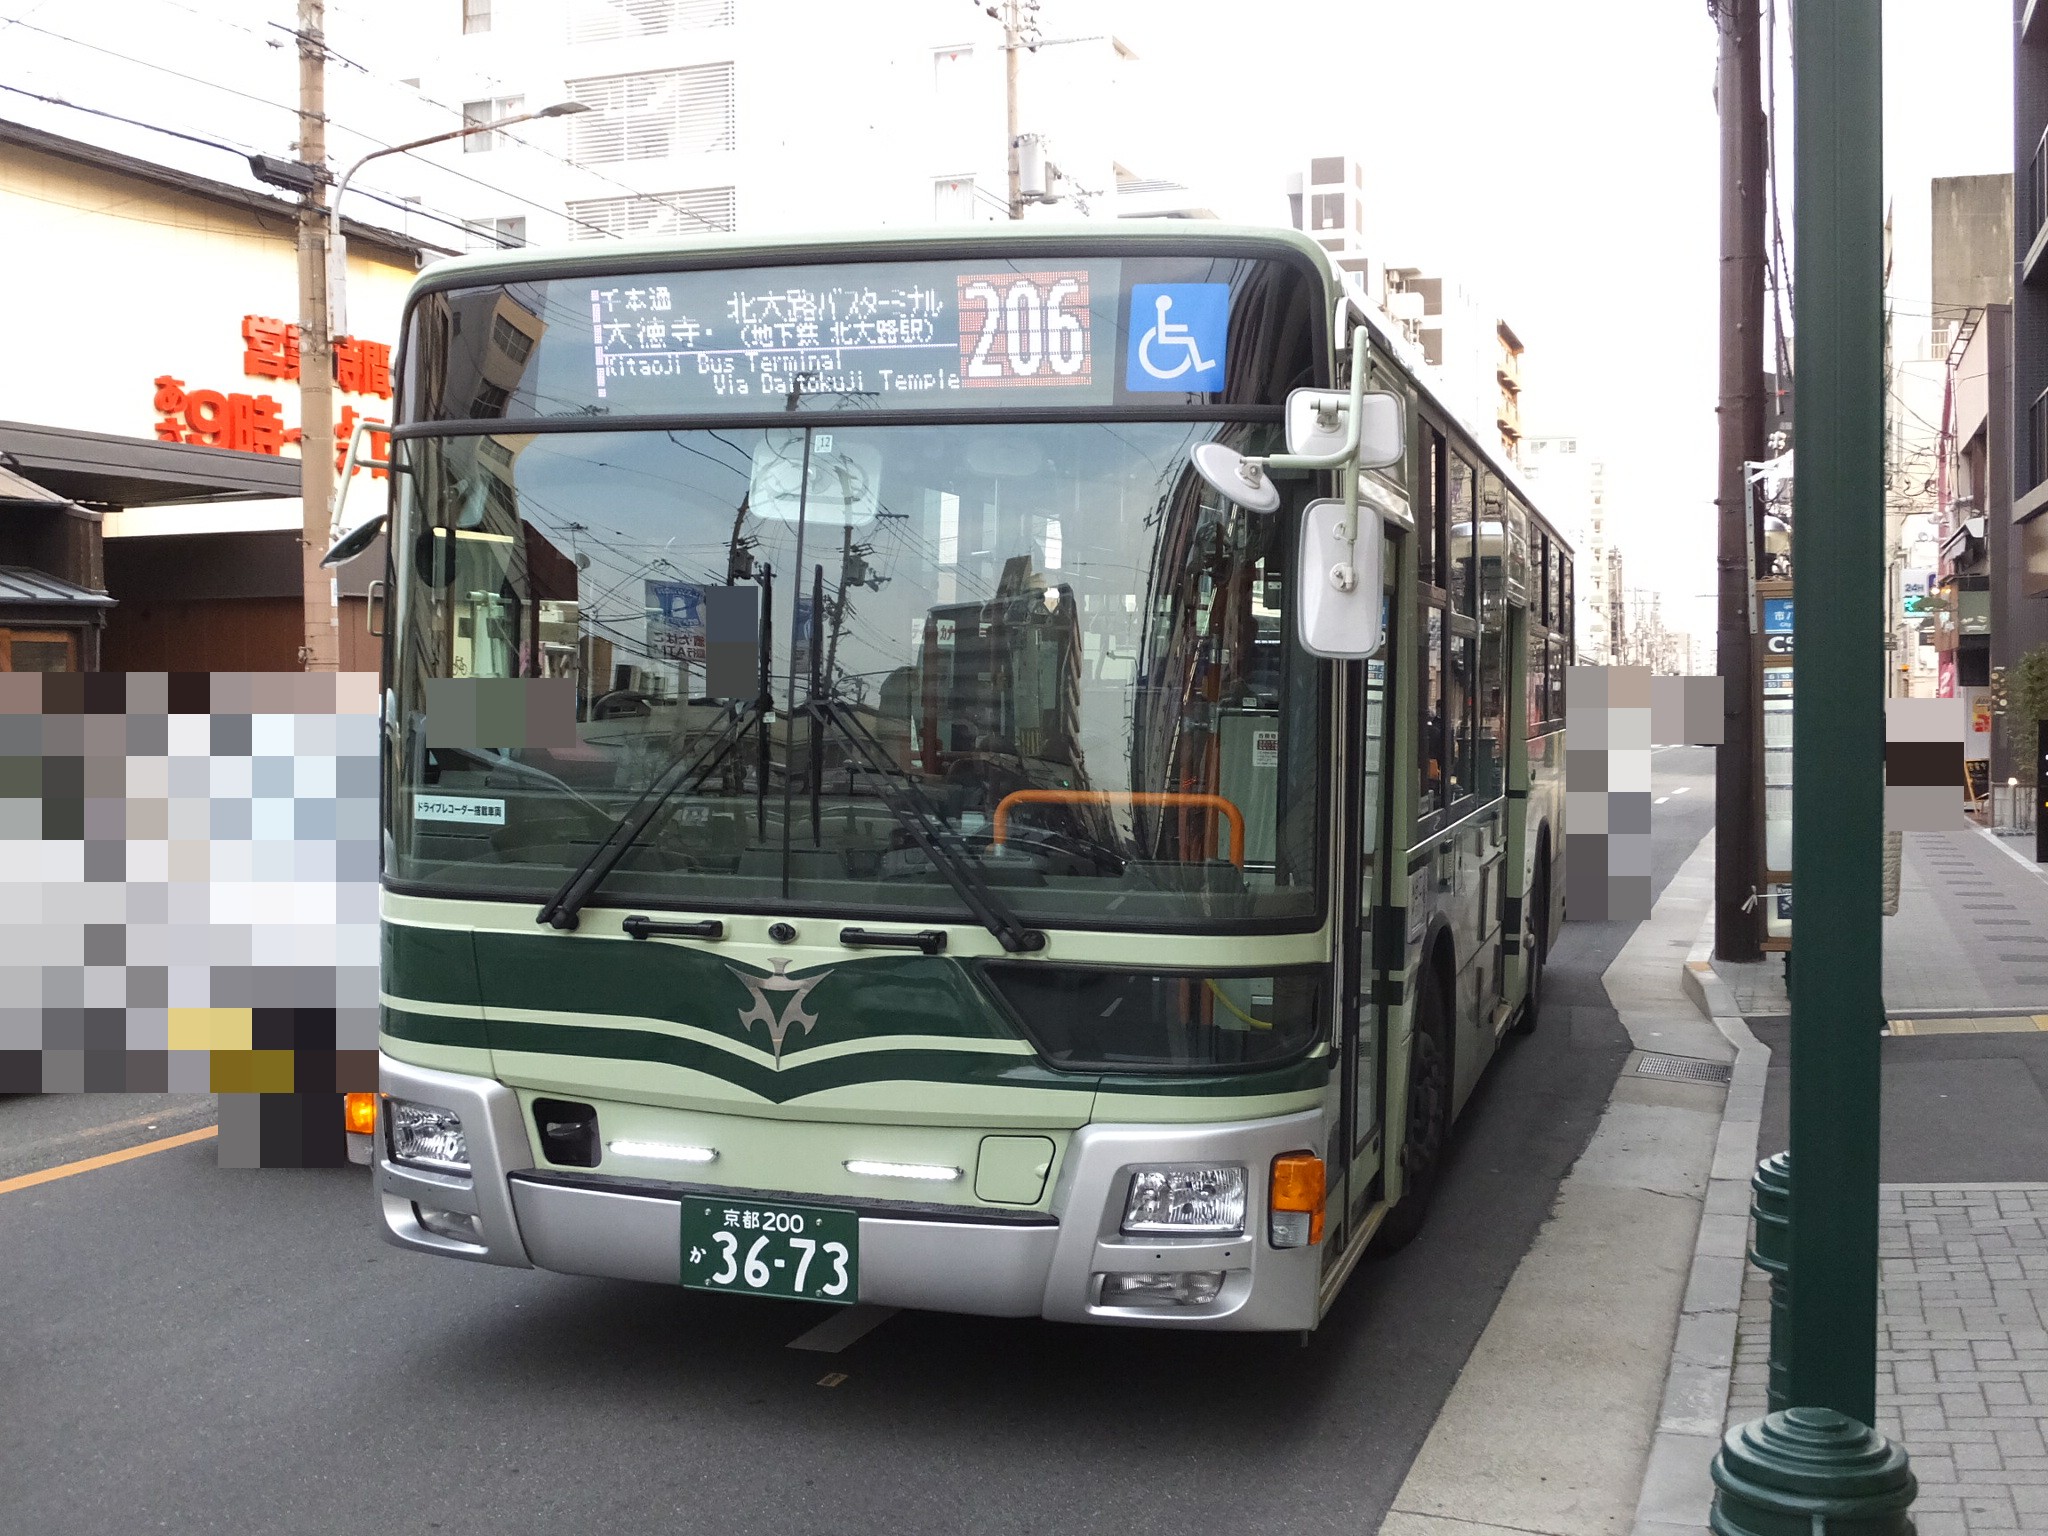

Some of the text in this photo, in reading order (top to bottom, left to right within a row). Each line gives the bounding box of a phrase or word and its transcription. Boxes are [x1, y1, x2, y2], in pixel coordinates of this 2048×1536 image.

[965, 278, 1084, 377] 206
[605, 350, 842, 377] Kitaoji Bus Terminal
[714, 369, 961, 396] Via Daitokuji Temple
[820, 436, 831, 448] 12
[689, 1230, 849, 1296] か 36-73
